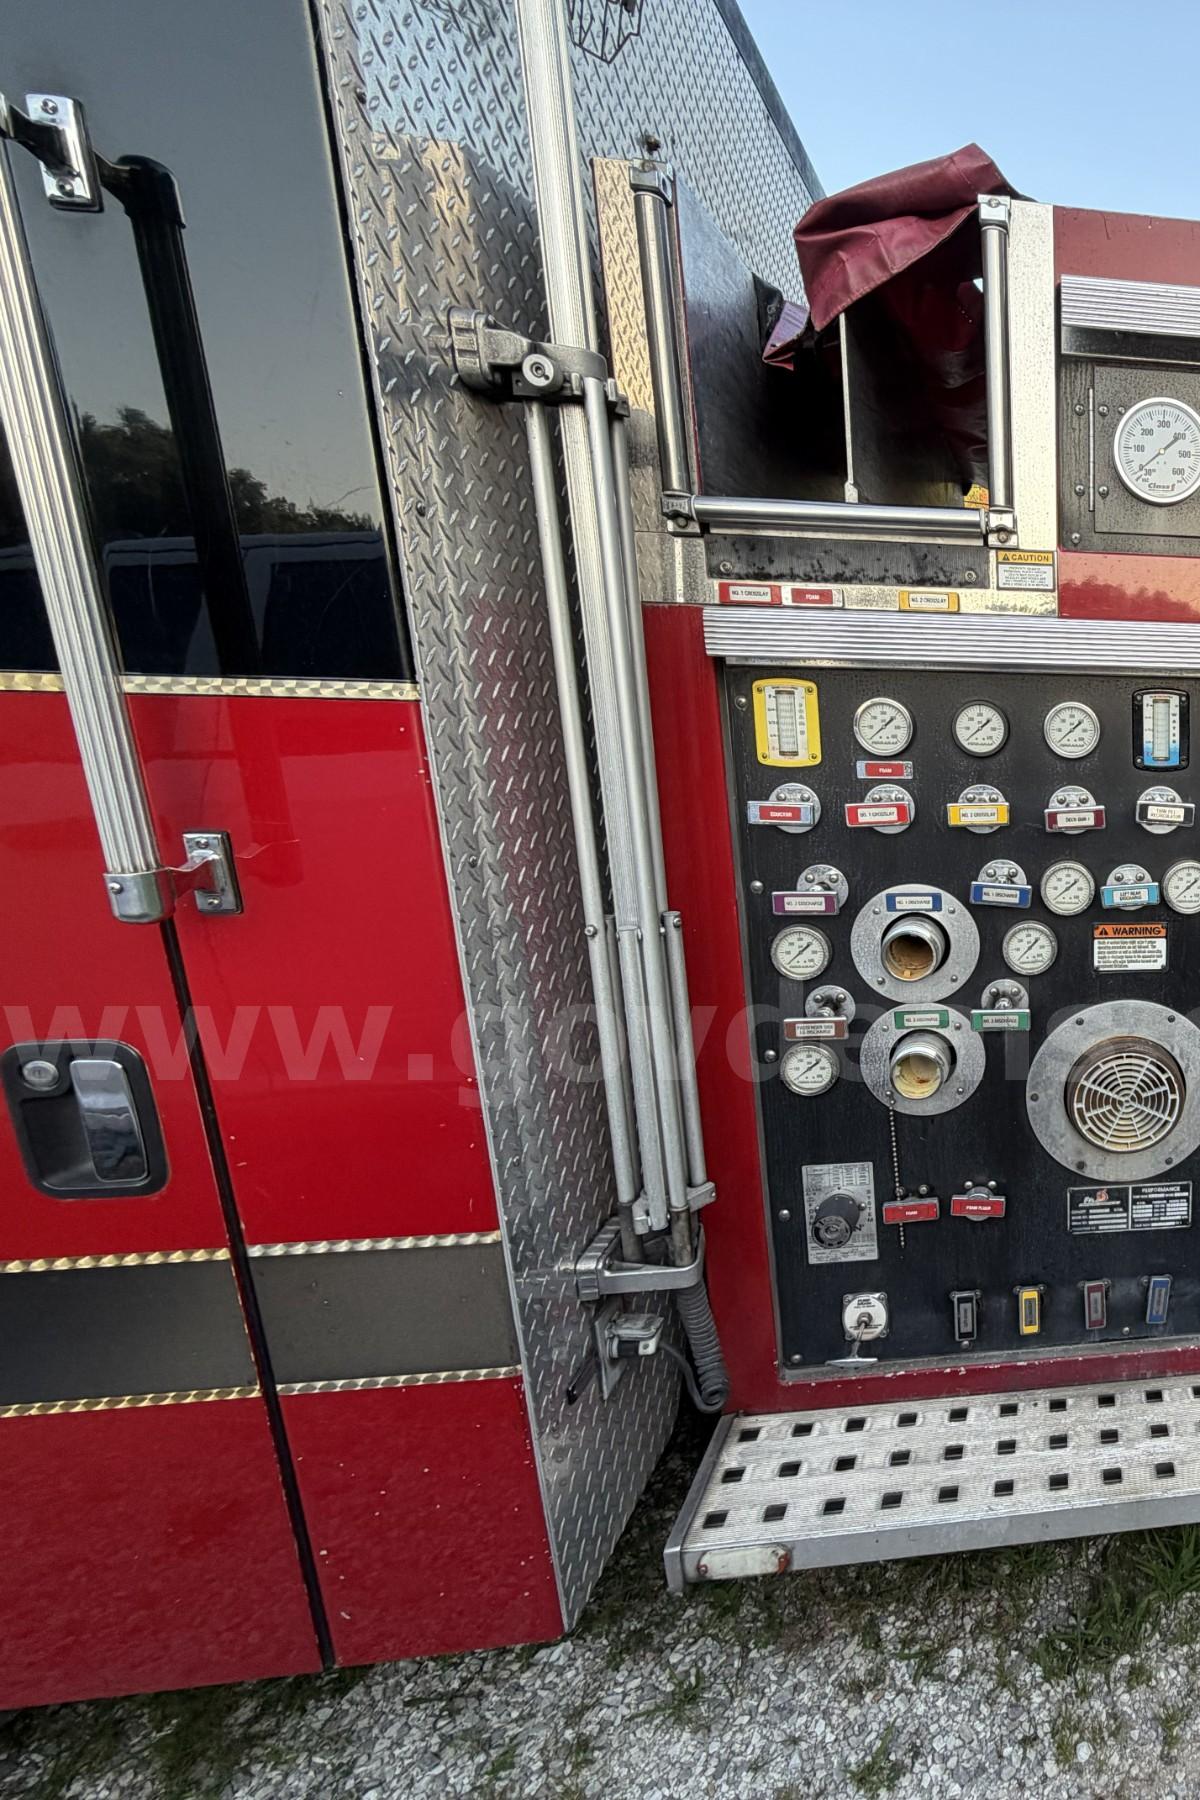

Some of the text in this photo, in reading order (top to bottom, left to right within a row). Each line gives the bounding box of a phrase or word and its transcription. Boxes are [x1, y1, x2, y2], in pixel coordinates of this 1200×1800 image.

[1157, 420, 1170, 428] 300
[1141, 428, 1154, 436] 200
[1133, 444, 1145, 452] 100
[1178, 450, 1191, 458] 500
[1172, 468, 1185, 476] 600
[1011, 554, 1049, 562] CAUTION
[1112, 927, 1162, 935] WARNING
